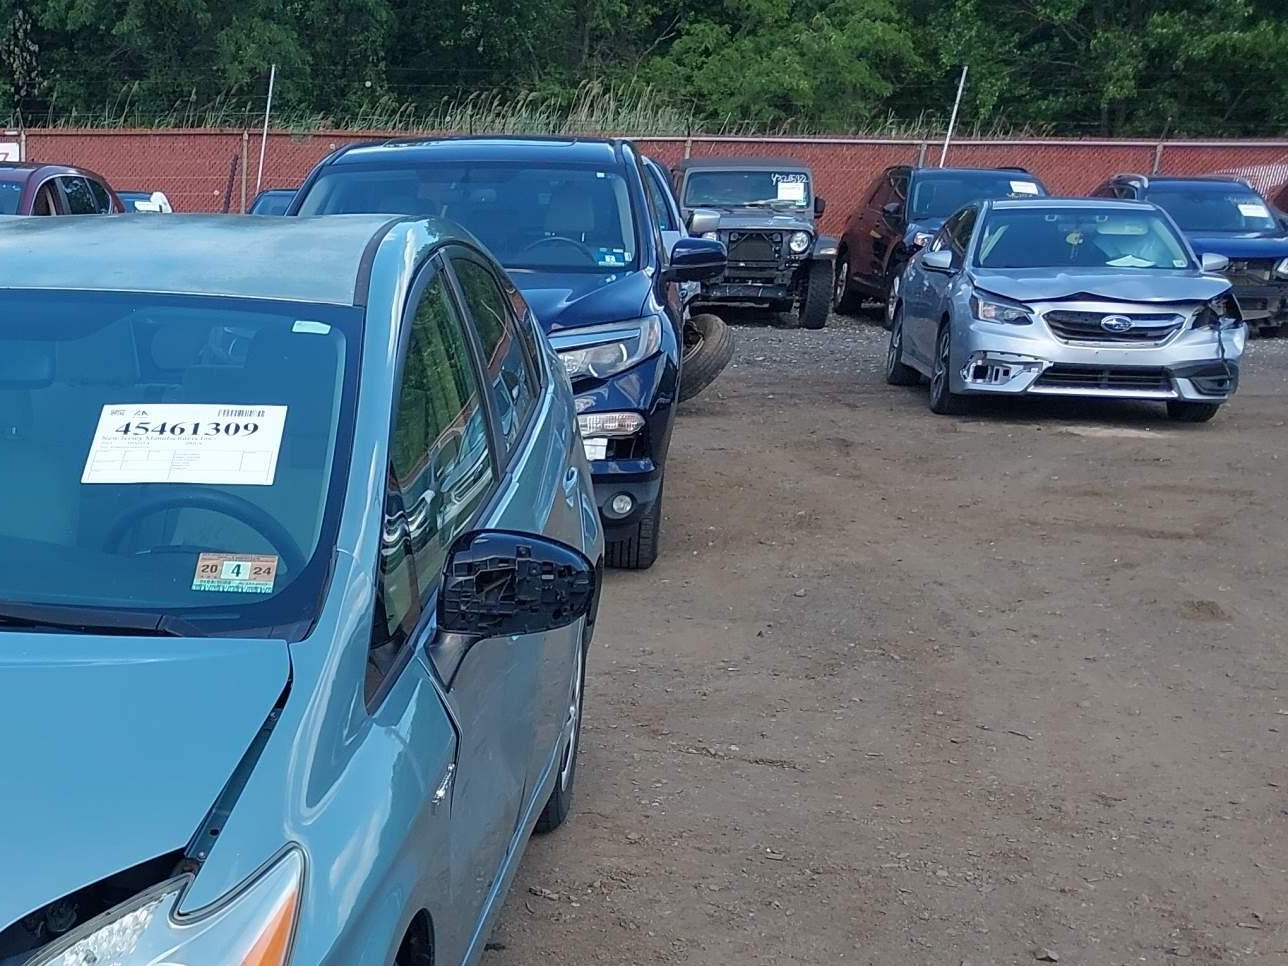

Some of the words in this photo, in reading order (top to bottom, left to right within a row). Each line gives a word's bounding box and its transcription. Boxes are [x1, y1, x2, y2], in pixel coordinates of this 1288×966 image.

[115, 421, 259, 436] 45461309
[201, 564, 219, 574] 20
[231, 564, 242, 577] 4
[253, 566, 272, 576] 24
